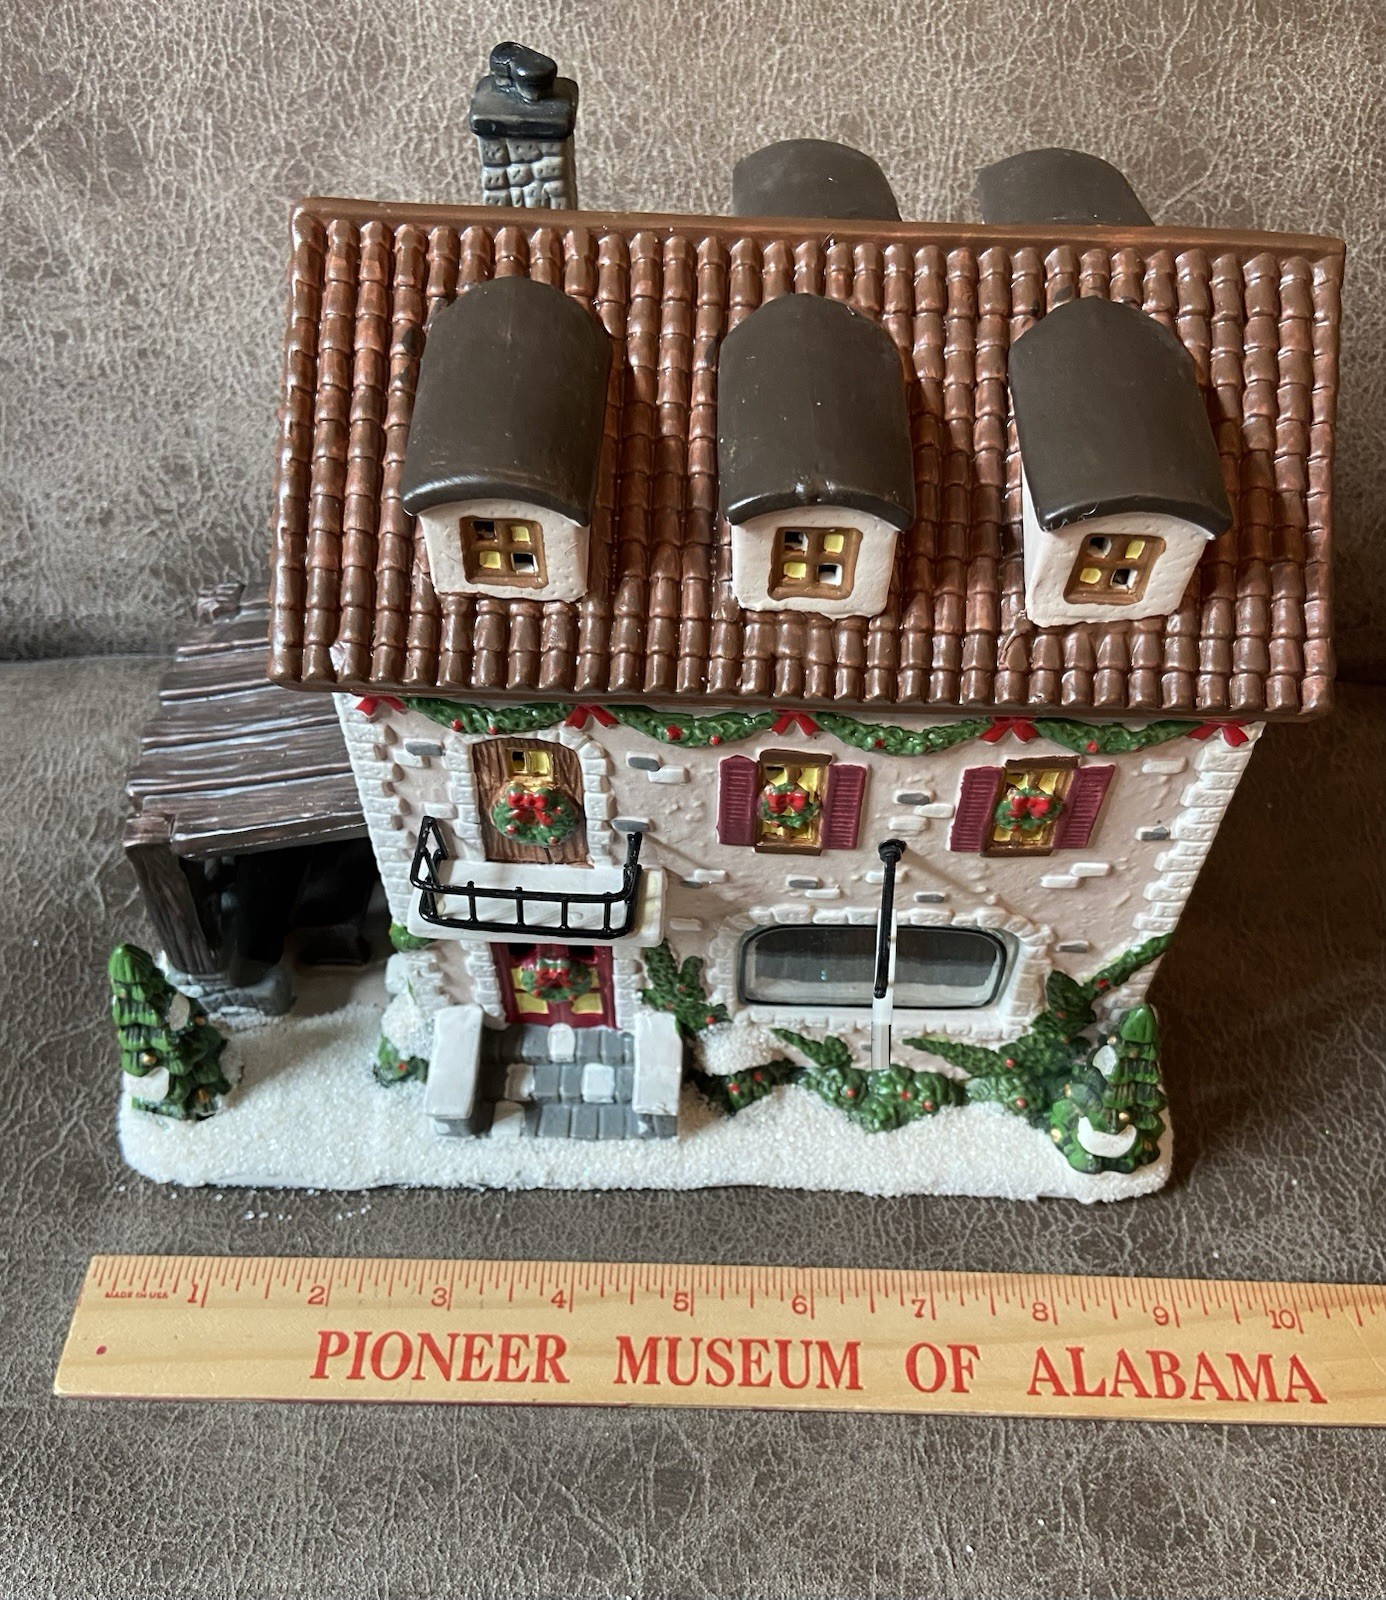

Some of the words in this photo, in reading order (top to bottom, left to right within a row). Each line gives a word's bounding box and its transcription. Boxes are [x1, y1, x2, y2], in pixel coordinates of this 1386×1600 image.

[105, 1291, 132, 1299] MADE
[136, 1291, 146, 1299] IN
[149, 1291, 168, 1299] USA
[187, 1283, 199, 1303] 1
[307, 1285, 326, 1306] 2
[431, 1287, 448, 1307] 3
[550, 1289, 567, 1309] 4
[673, 1292, 689, 1312] 5
[791, 1295, 808, 1315] 6
[911, 1299, 926, 1318] 7
[1032, 1301, 1049, 1322] 8
[1153, 1305, 1169, 1326] 9
[1269, 1309, 1296, 1330] 10
[309, 1330, 570, 1384] PIONEER
[613, 1335, 864, 1391] MUSEUM
[905, 1342, 981, 1393] OF
[1026, 1346, 1328, 1404] ALABAMA
